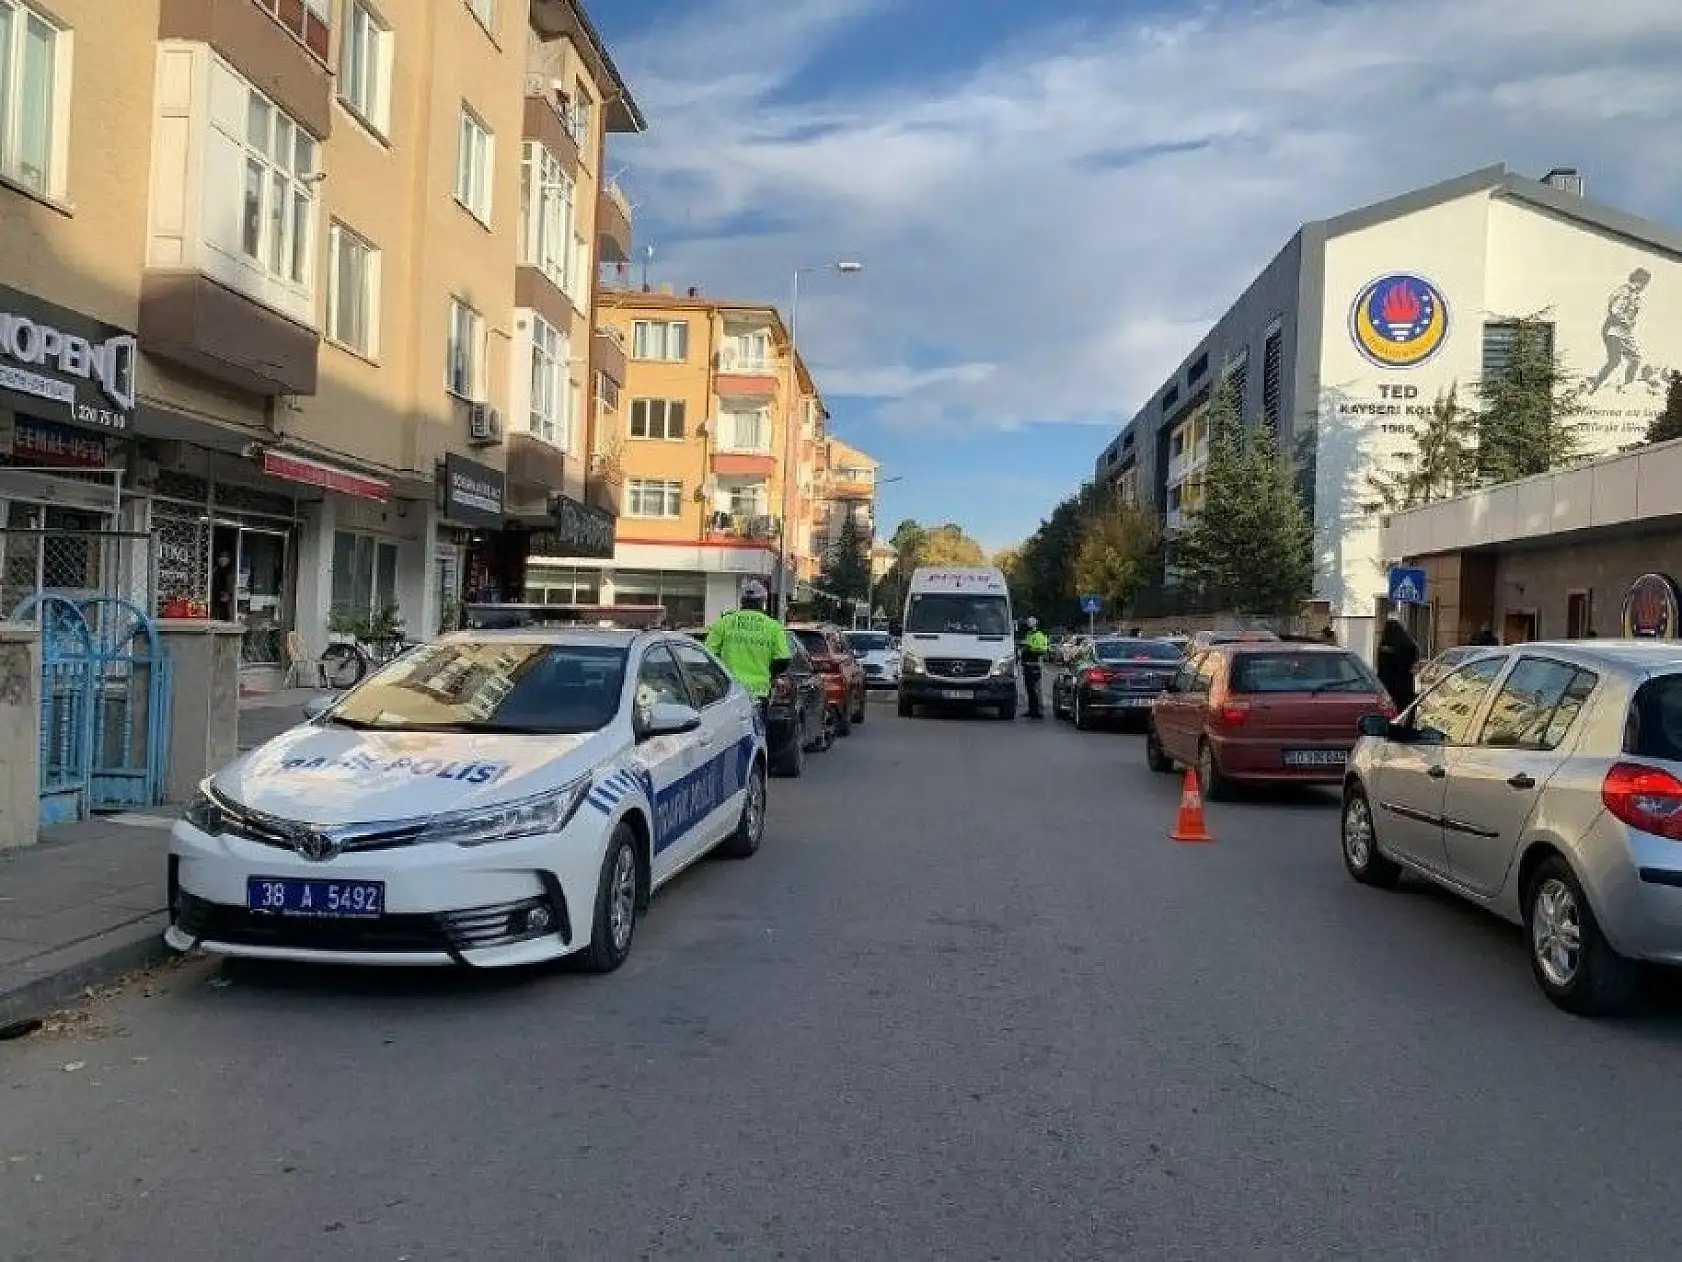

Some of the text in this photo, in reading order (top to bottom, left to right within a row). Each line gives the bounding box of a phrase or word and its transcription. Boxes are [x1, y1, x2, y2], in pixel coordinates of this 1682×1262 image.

[1379, 384, 1418, 398] TED
[262, 882, 378, 911] 38 A 5492
